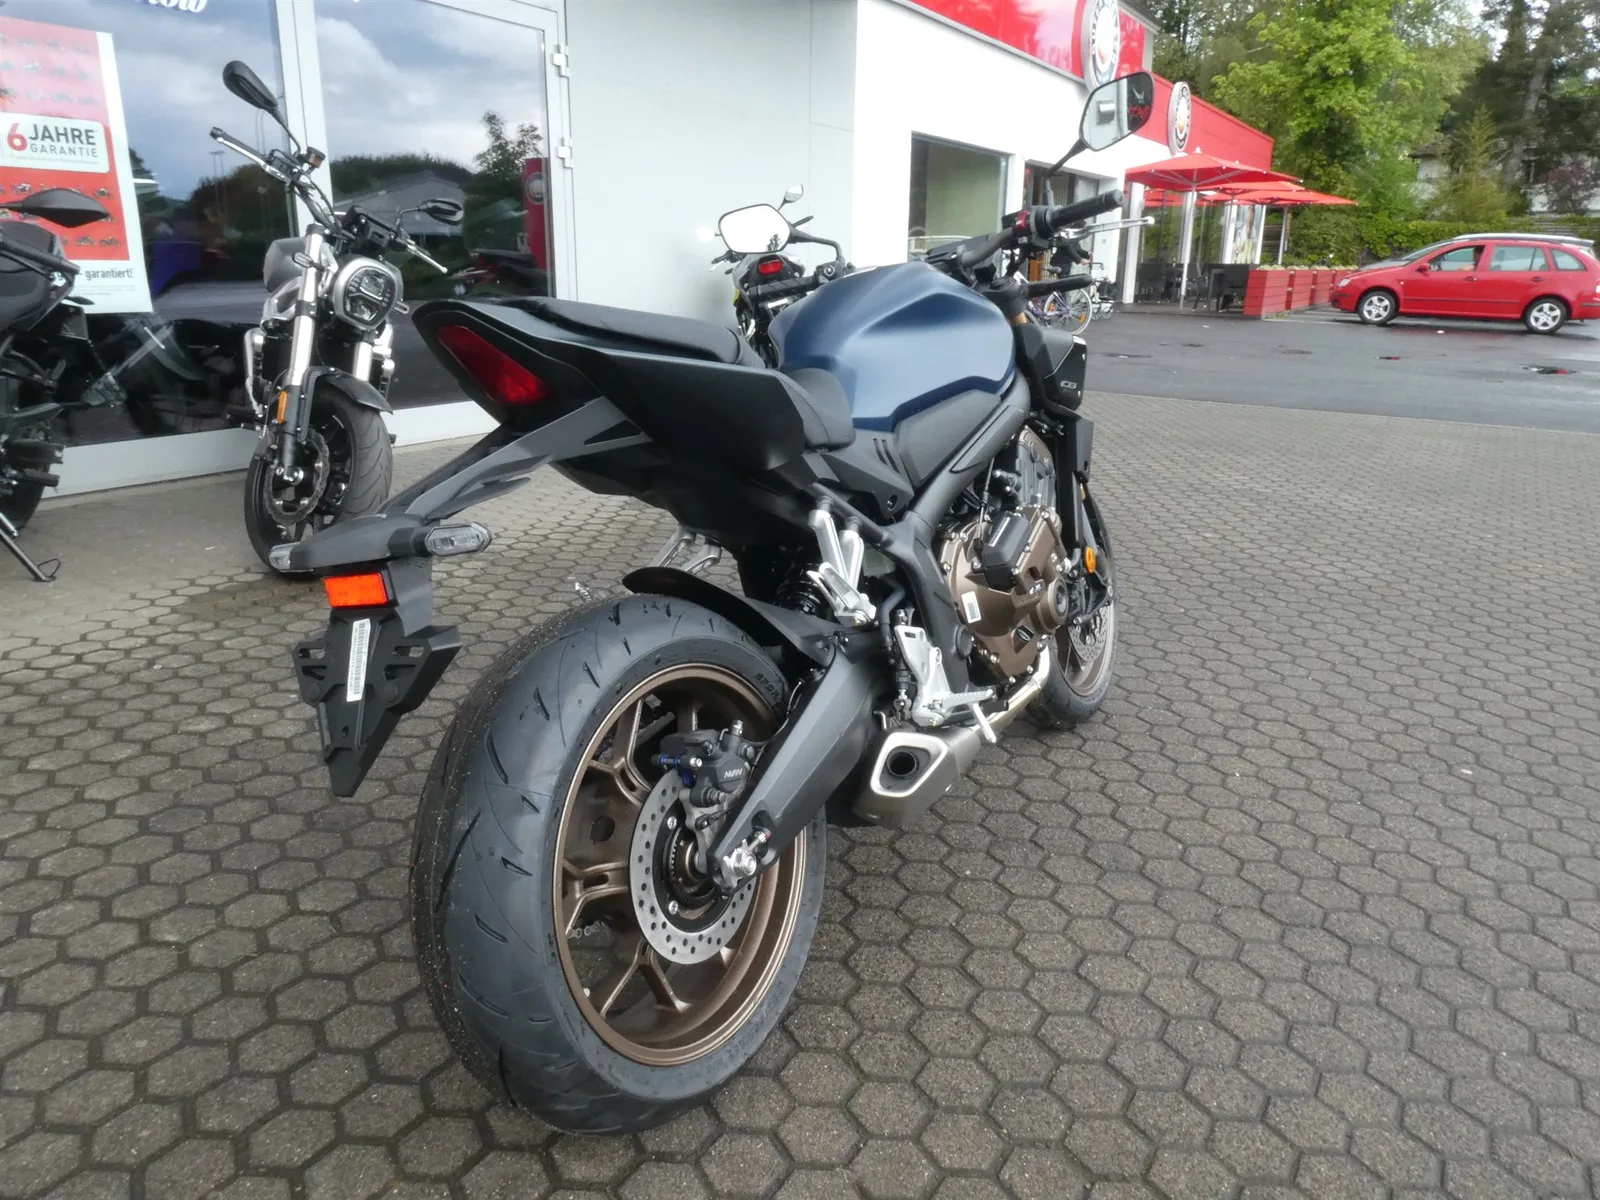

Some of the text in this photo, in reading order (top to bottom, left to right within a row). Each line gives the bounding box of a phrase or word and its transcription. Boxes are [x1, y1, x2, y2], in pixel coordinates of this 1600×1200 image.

[7, 122, 97, 151] 6 JAHRE
[30, 143, 98, 158] GARANTIE
[85, 267, 133, 280] garantiert!
